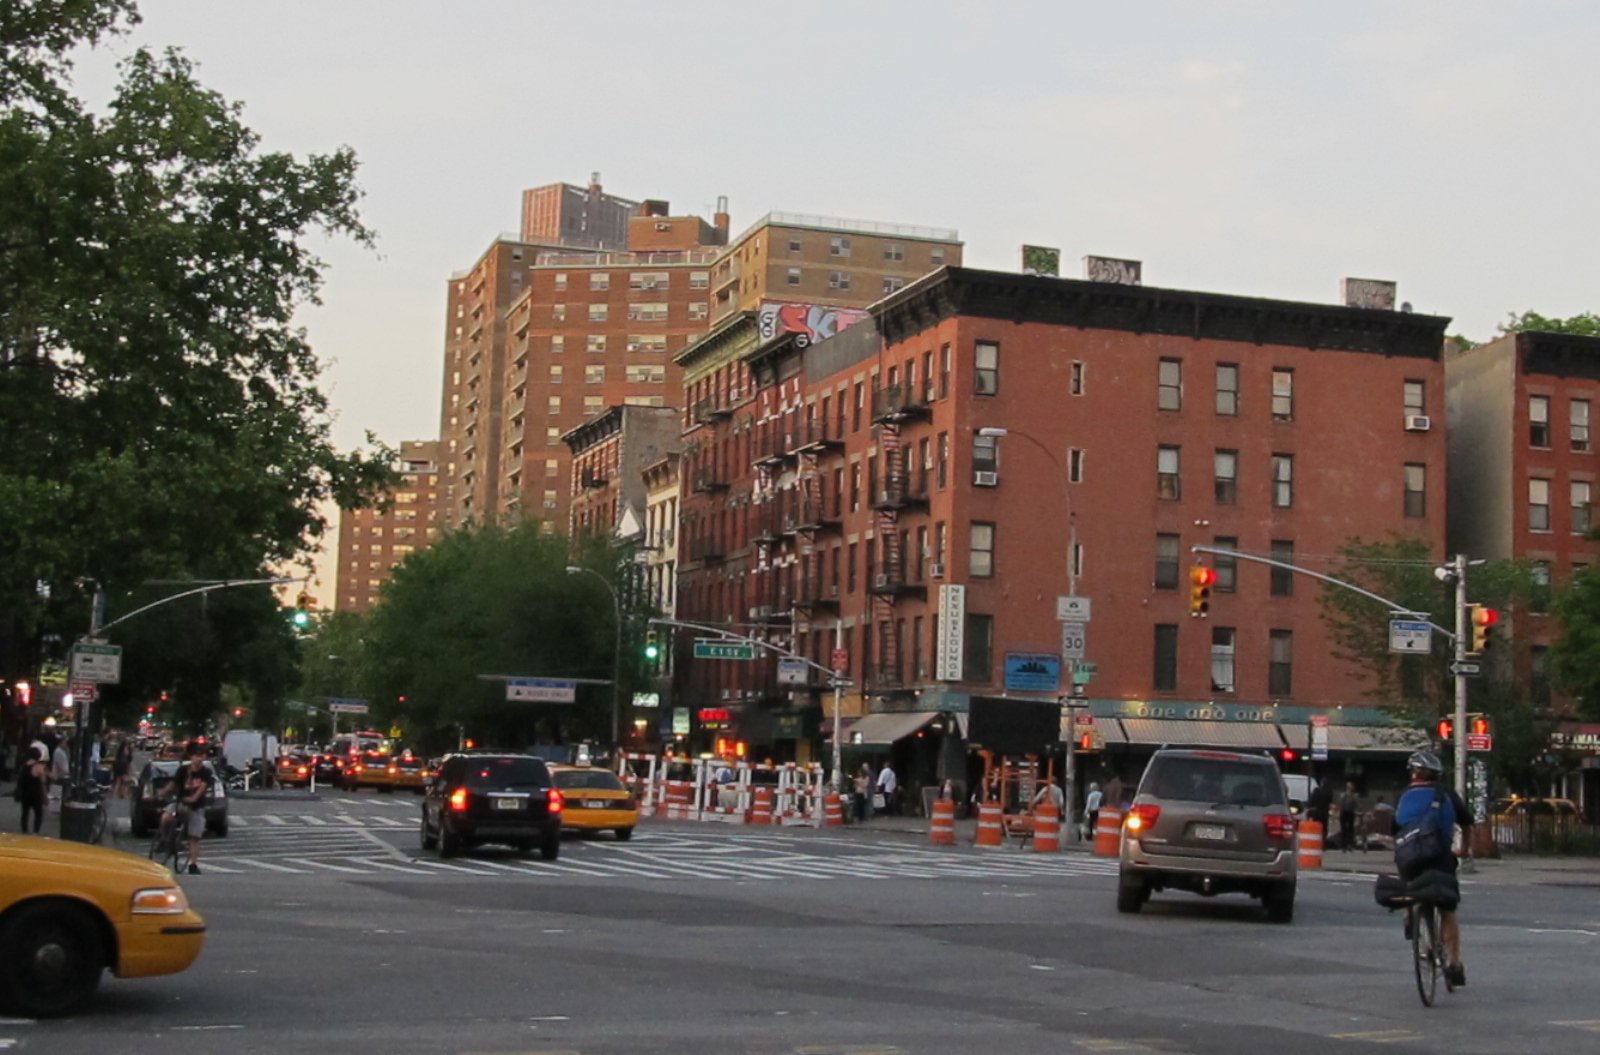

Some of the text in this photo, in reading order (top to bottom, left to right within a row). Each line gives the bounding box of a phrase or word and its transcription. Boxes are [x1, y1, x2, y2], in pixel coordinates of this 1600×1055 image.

[948, 587, 960, 678] NEXUS LOUNGE
[1065, 637, 1083, 649] 30
[1137, 705, 1273, 721] one and one
